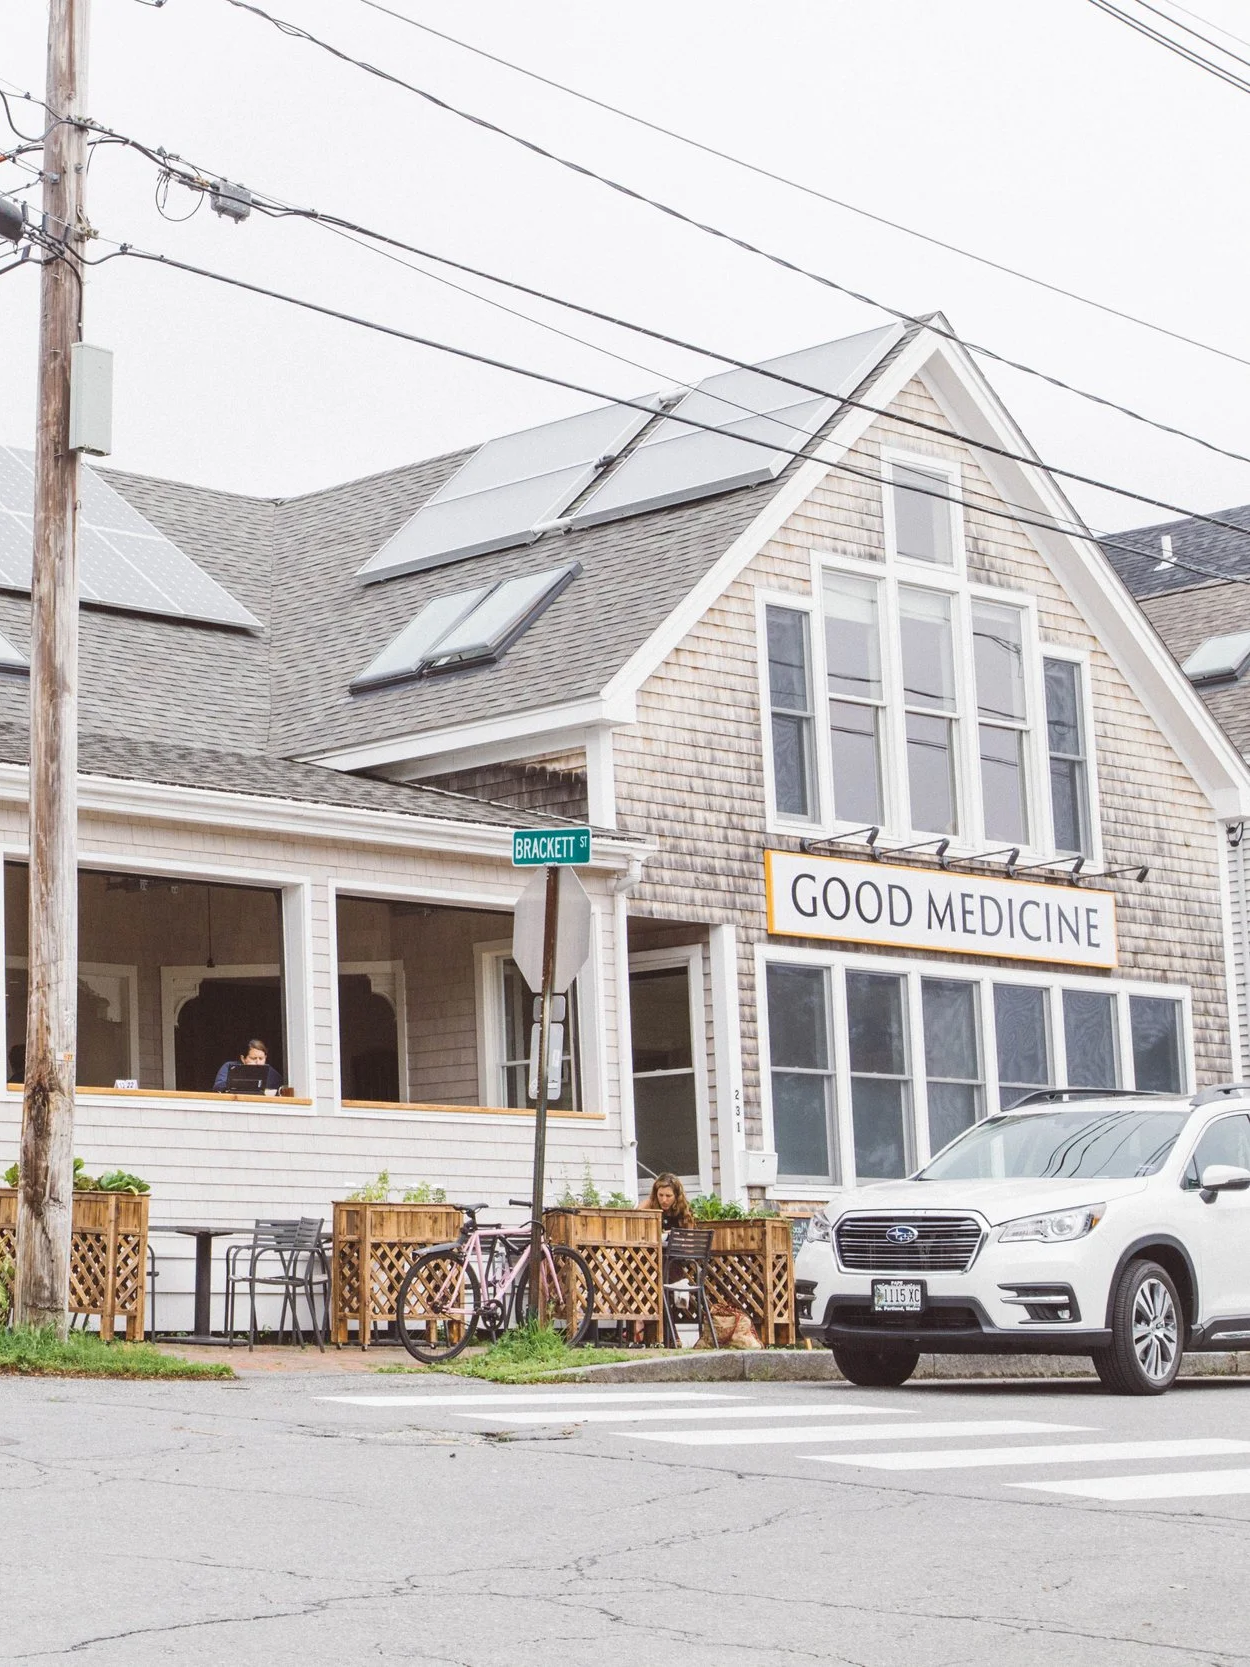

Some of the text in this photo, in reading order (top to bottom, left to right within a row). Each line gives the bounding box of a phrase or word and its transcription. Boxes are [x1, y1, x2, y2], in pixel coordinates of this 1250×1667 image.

[515, 836, 588, 859] BRACKETT ST
[790, 873, 1101, 948] GOOD MEDICINE
[884, 1288, 920, 1302] 1115 XC
